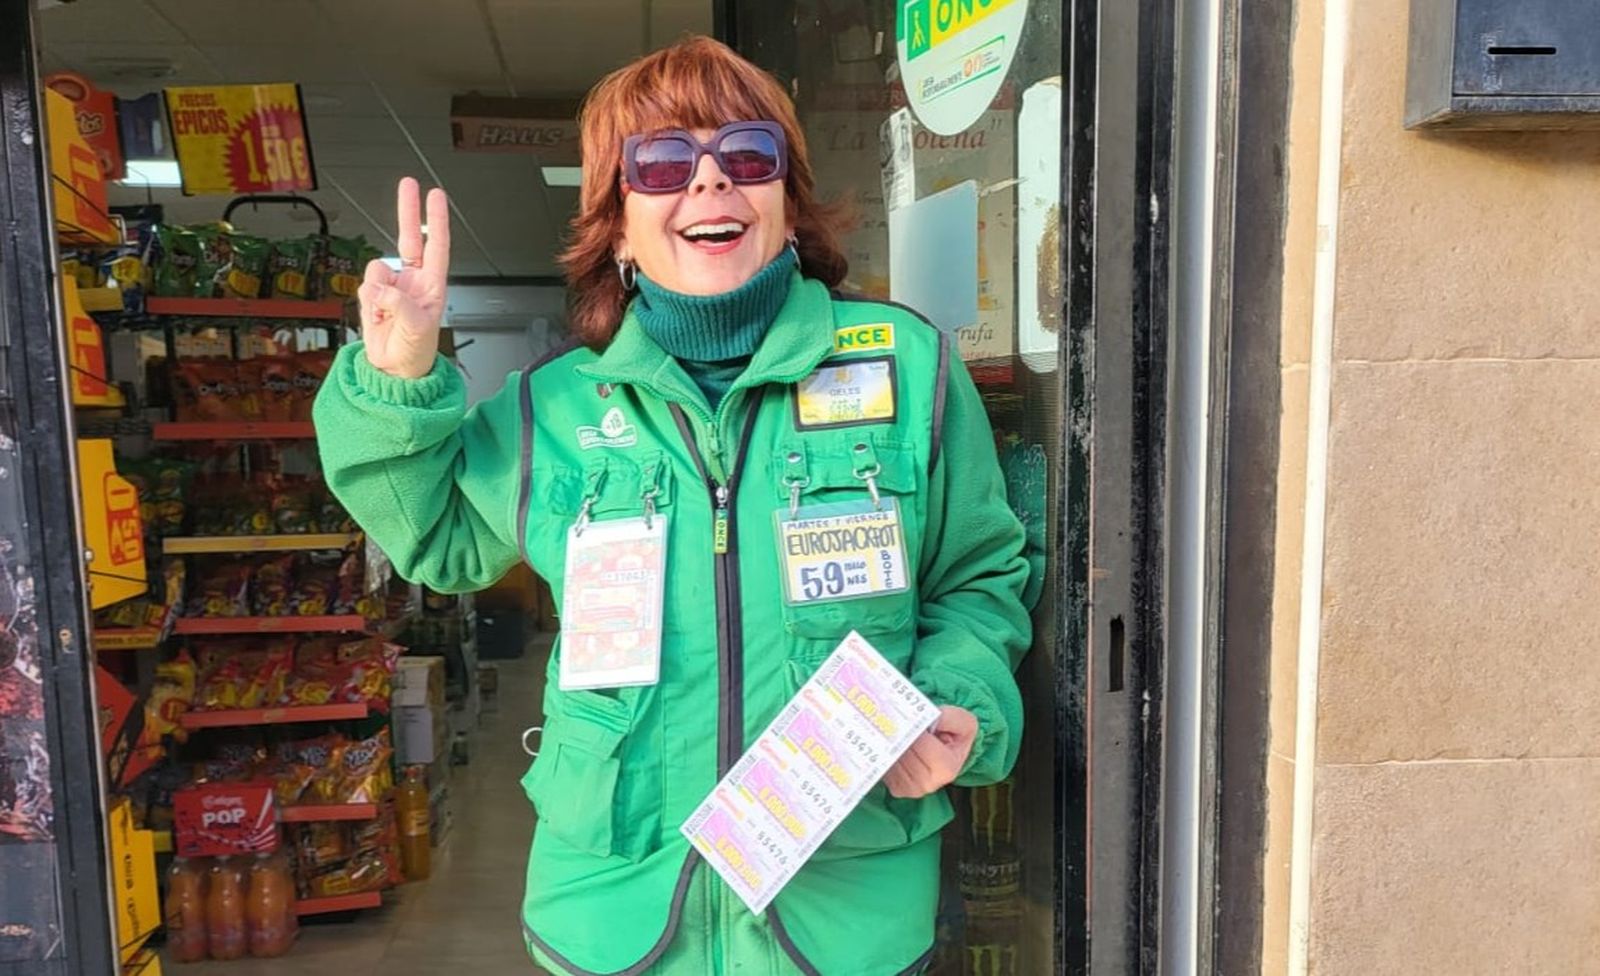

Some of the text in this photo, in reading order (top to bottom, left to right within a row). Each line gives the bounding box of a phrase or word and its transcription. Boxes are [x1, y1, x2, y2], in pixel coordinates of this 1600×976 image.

[480, 126, 561, 146] HALLS
[838, 329, 886, 348] NCE
[786, 523, 898, 556] EUROJACKPOT
[801, 562, 845, 599] 59
[880, 549, 894, 588] BOTE
[202, 808, 247, 828] POP
